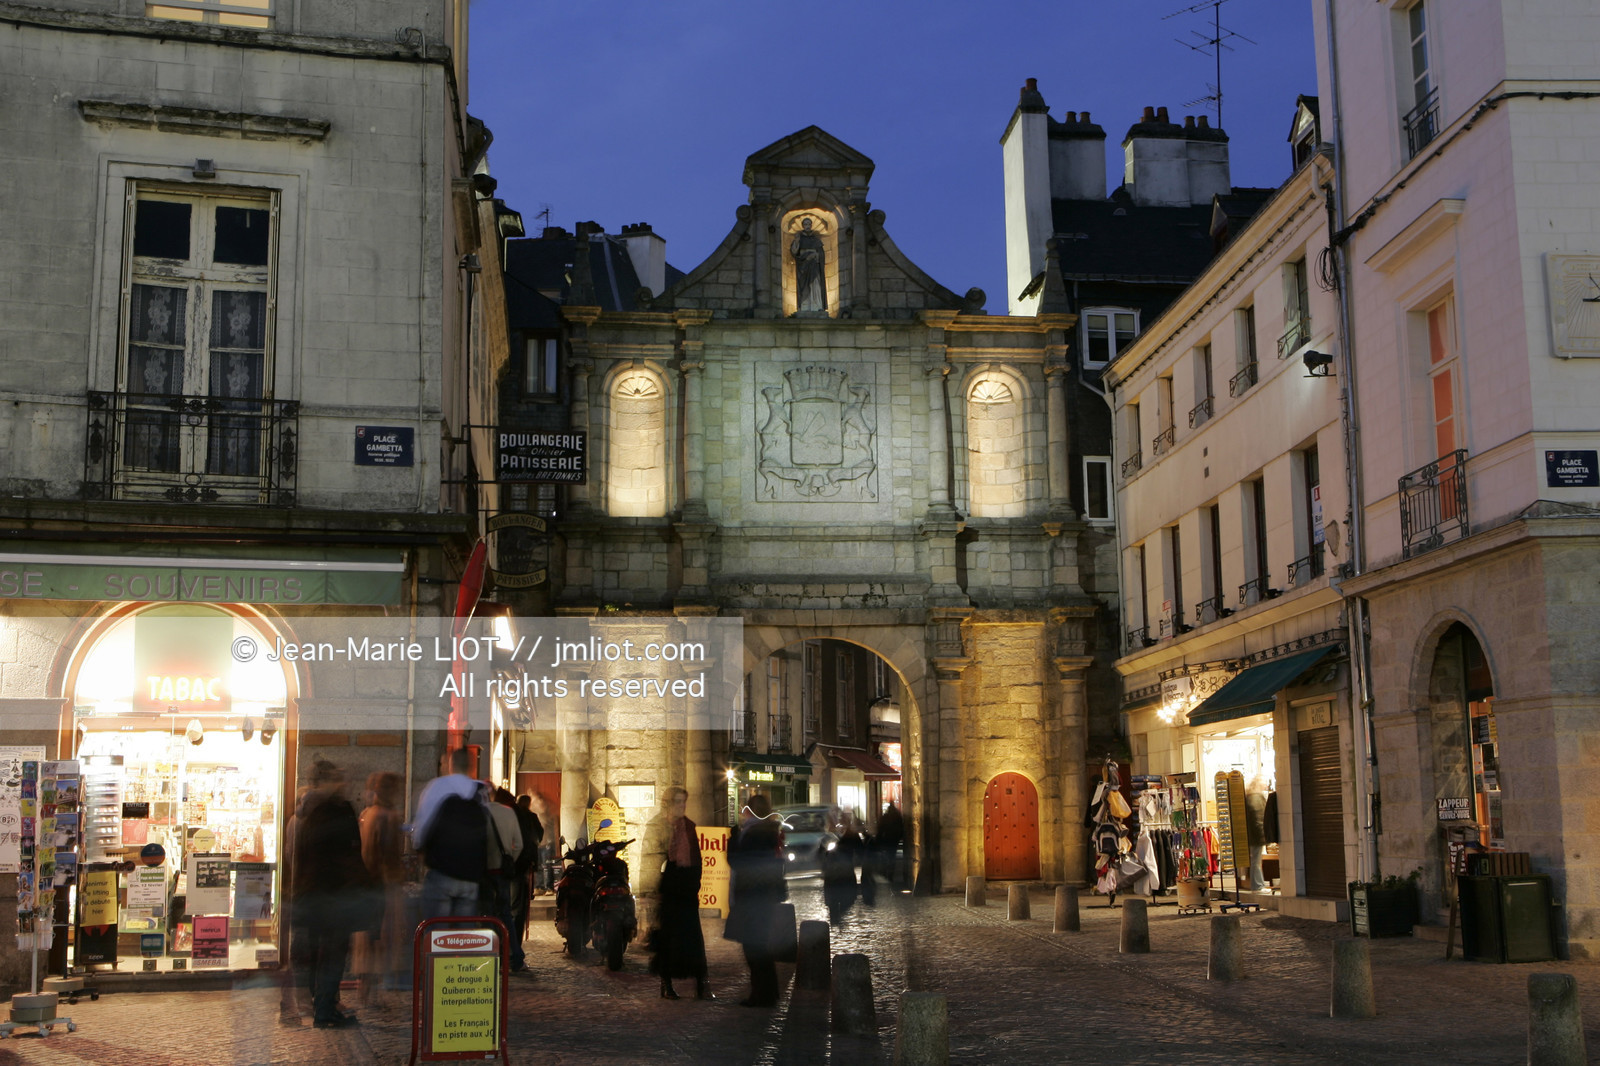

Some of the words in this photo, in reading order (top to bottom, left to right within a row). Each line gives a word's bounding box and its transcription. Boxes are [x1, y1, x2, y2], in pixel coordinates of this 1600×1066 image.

[373, 435, 396, 443] PLACE
[500, 433, 583, 451] BOULANGERIE
[366, 444, 403, 452] GAMBETTA
[500, 454, 582, 470] PATISSERIE
[535, 471, 582, 481] BRETONNES
[492, 514, 543, 529] BOULANGER
[496, 573, 542, 586] PATISSIER
[104, 573, 302, 600] SOUVENIRS
[147, 675, 222, 702] TABAC
[446, 938, 487, 947] Télégramme
[446, 976, 454, 984] de
[457, 976, 483, 984] drogue
[485, 974, 489, 982] à
[442, 986, 475, 995] Quiberon
[441, 998, 493, 1007] interpellations
[444, 1019, 457, 1027] Les
[460, 1018, 490, 1028] Français
[449, 1030, 468, 1040] piste
